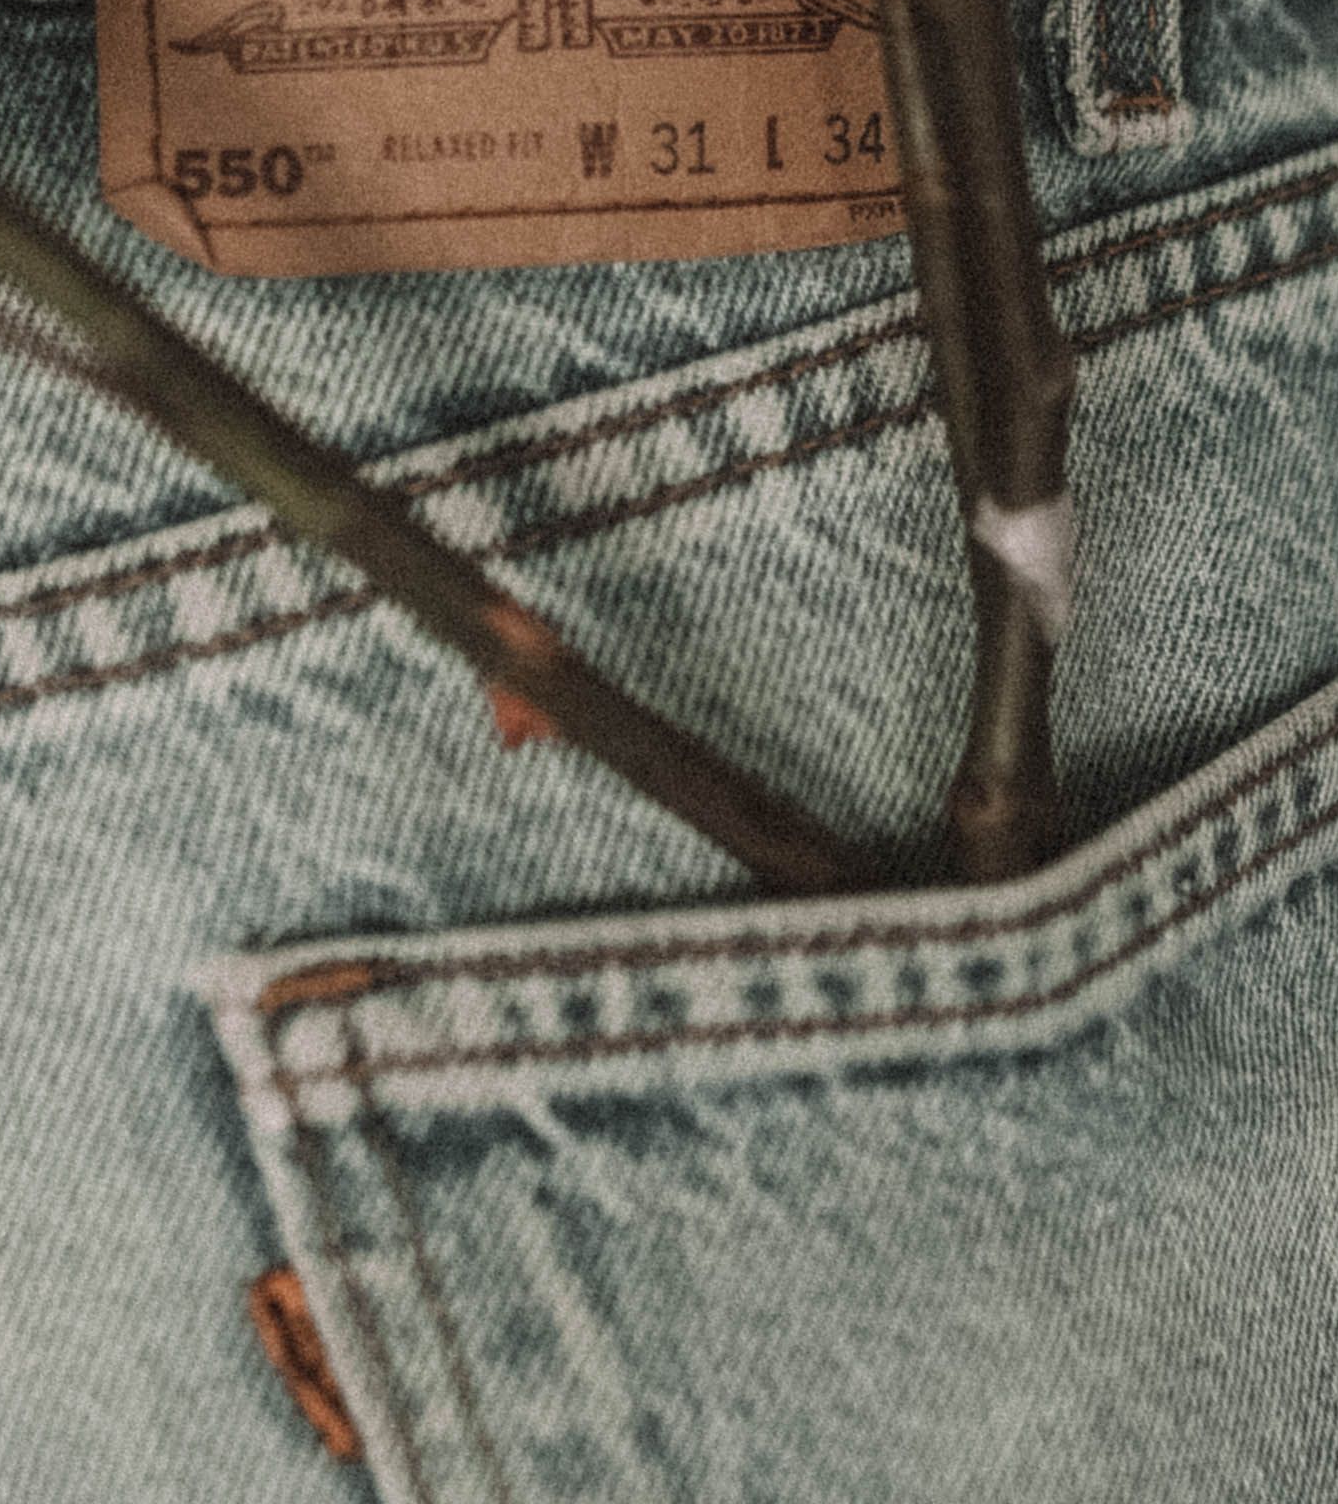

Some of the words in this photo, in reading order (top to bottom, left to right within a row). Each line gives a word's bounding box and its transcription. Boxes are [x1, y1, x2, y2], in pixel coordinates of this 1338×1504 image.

[579, 121, 619, 179] W
[649, 119, 716, 176] 31
[823, 112, 885, 167] 34
